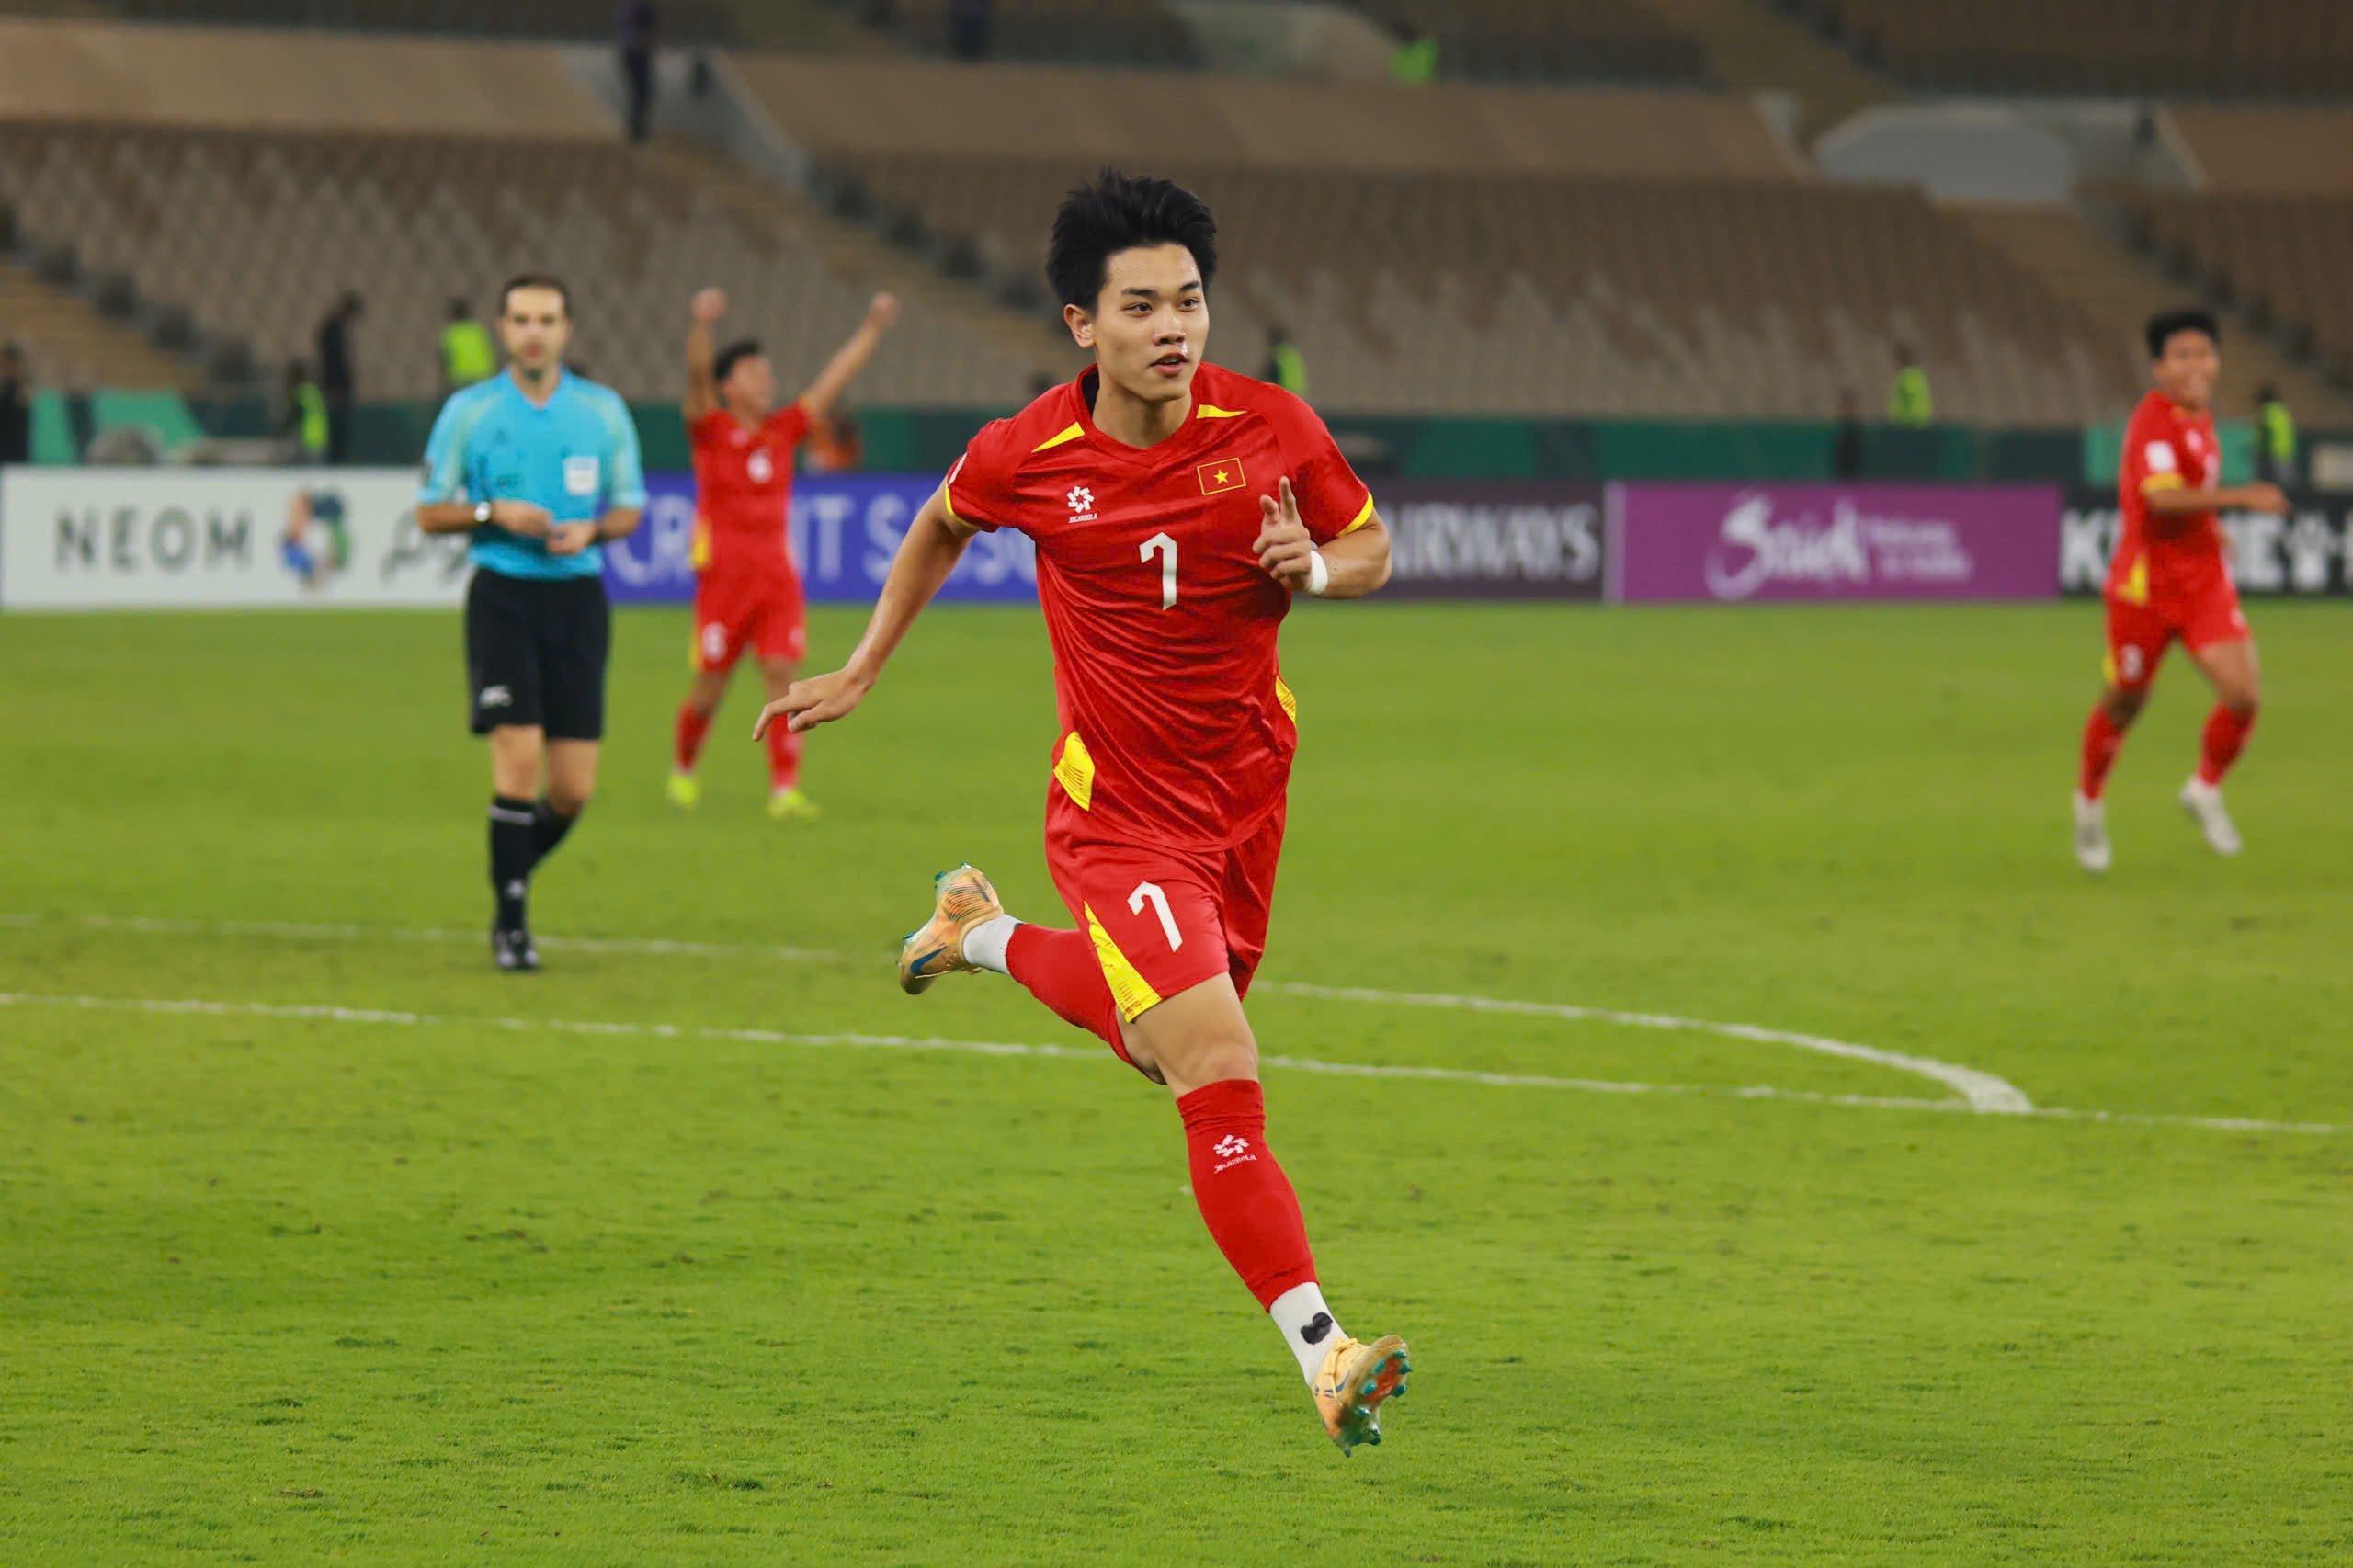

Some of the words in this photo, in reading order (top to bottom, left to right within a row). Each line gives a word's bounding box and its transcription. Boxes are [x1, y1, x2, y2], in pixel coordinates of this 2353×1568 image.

[53, 504, 254, 574] NEOM
[606, 494, 855, 585] CRIT
[1139, 531, 1178, 610] 7
[1127, 881, 1183, 953] 7
